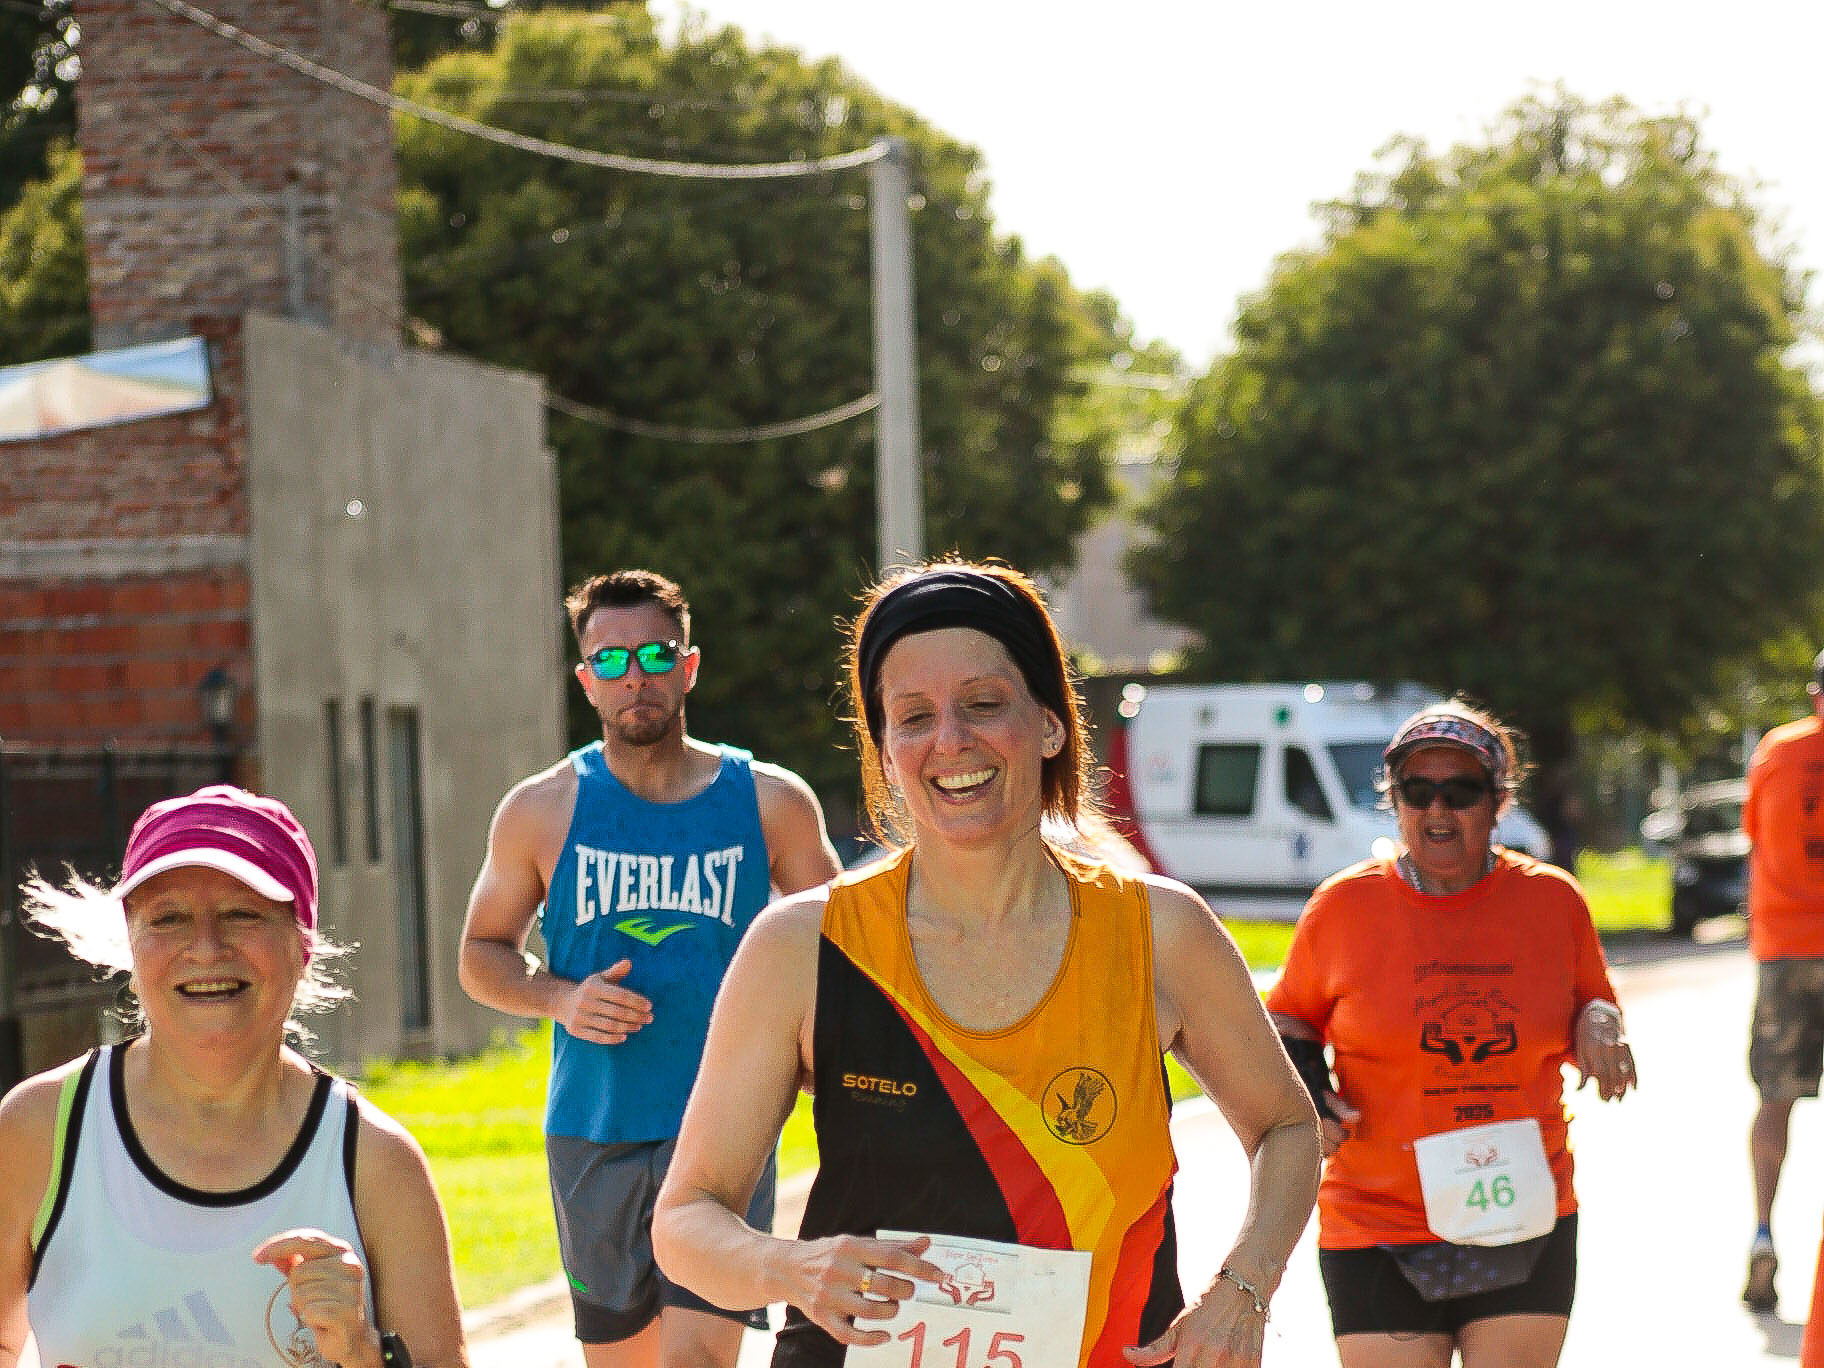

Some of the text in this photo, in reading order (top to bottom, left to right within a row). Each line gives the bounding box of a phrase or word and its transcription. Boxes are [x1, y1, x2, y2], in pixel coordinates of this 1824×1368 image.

[575, 843, 744, 929] EVERLAST
[842, 1074, 917, 1097] SOTELO
[1465, 1174, 1515, 1212] 46
